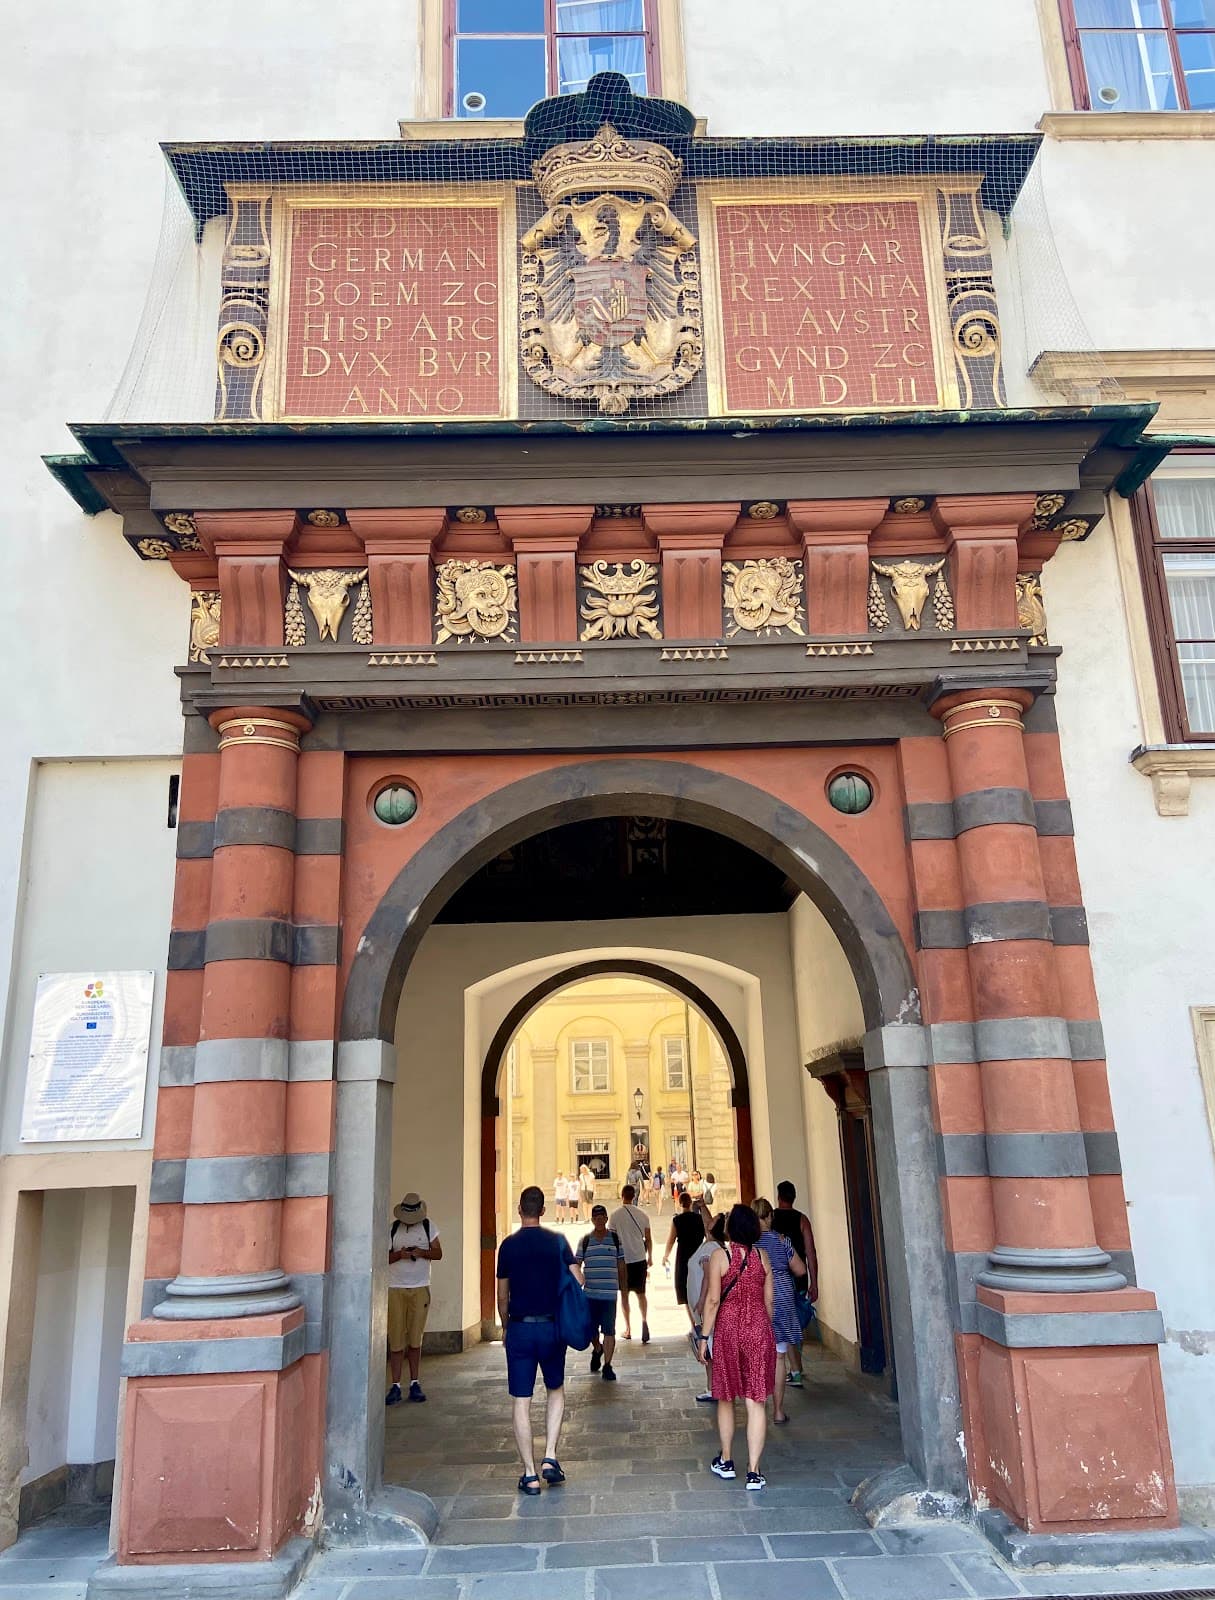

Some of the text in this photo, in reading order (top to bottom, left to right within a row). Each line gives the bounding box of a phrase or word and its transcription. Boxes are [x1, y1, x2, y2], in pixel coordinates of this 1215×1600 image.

[727, 204, 897, 234] DVS ROM
[308, 242, 487, 272] GERMAN
[729, 238, 904, 268] HVNGAR
[304, 277, 419, 307] BOEM
[731, 271, 920, 302] REX INFA
[303, 311, 495, 342] HISP ARC
[733, 307, 921, 337] HI AVSTR
[301, 346, 493, 377] DVX BVR
[736, 346, 848, 371] GVND
[342, 384, 464, 413] ANNO
